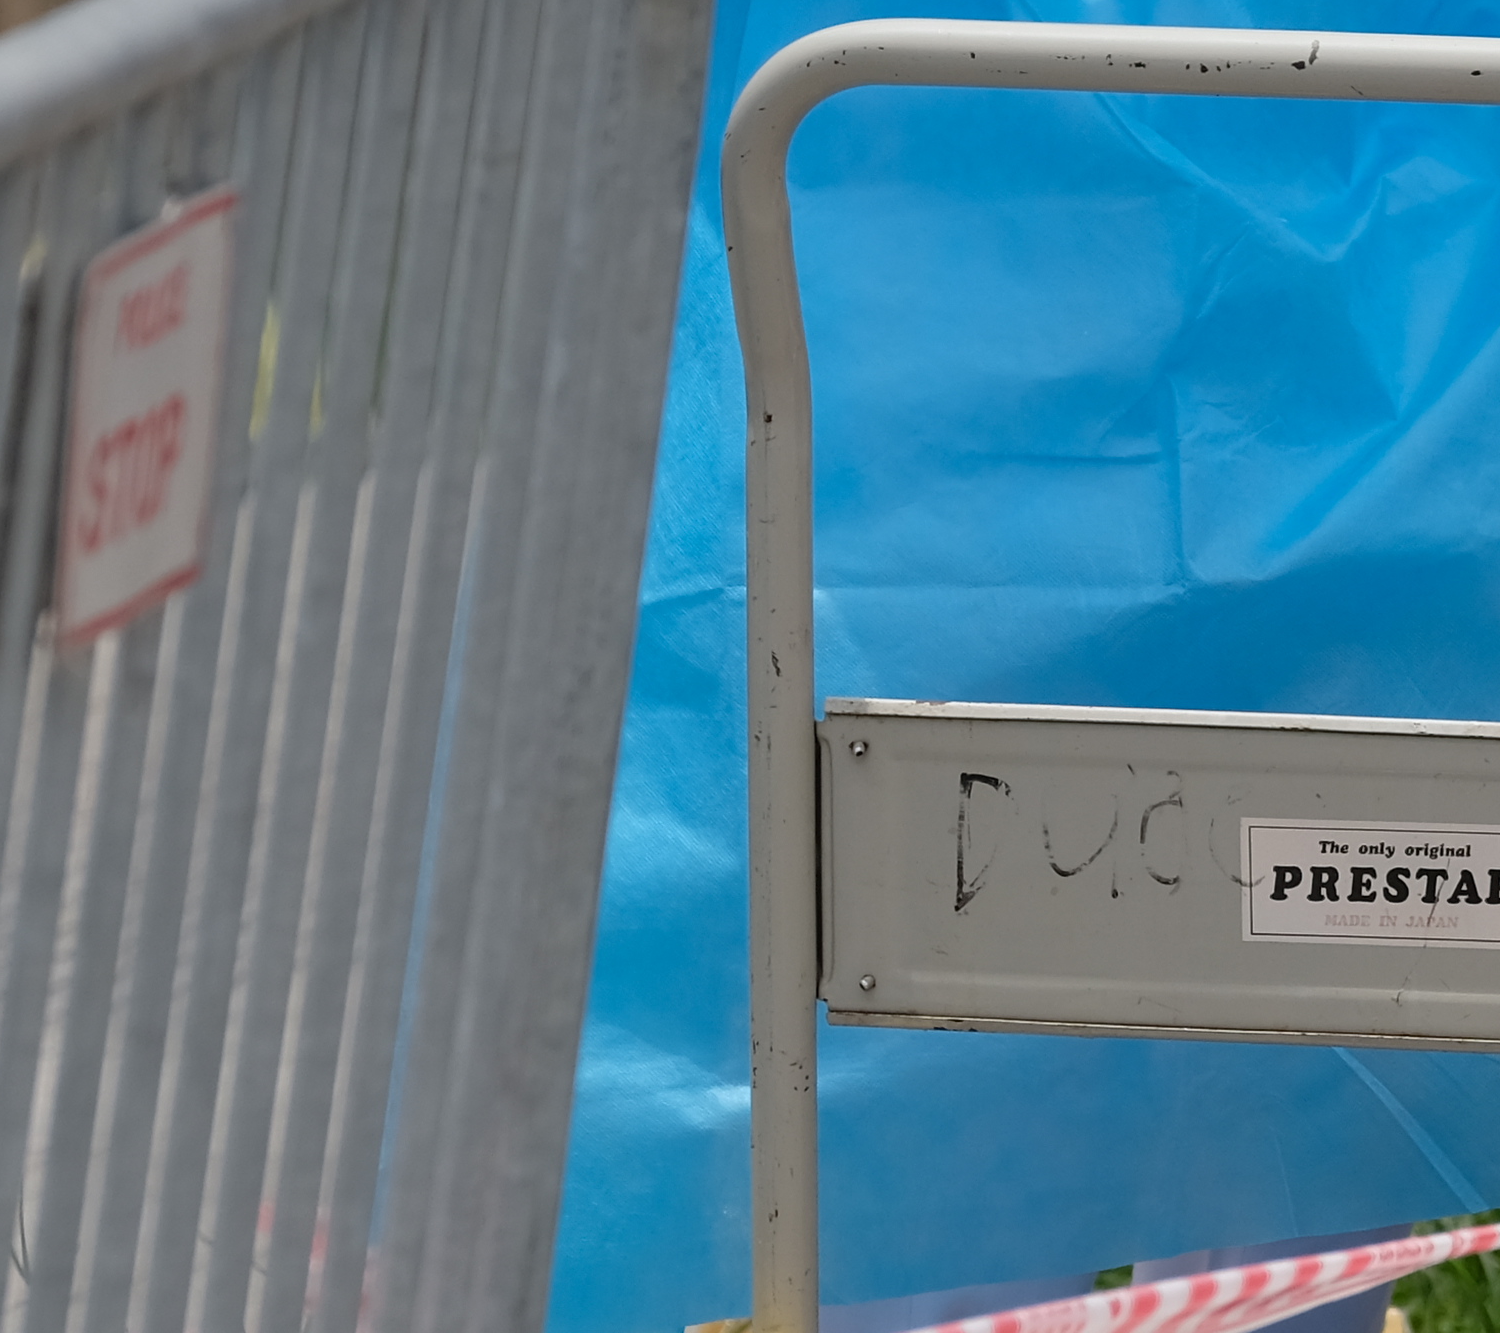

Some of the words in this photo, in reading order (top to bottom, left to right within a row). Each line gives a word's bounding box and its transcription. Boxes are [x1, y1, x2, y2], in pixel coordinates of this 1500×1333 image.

[1318, 840, 1349, 855] The
[1358, 842, 1396, 858] only
[1404, 843, 1471, 859] original
[1324, 913, 1371, 928] MADE
[1379, 914, 1398, 928] IN
[1405, 915, 1460, 929] JAPAN
